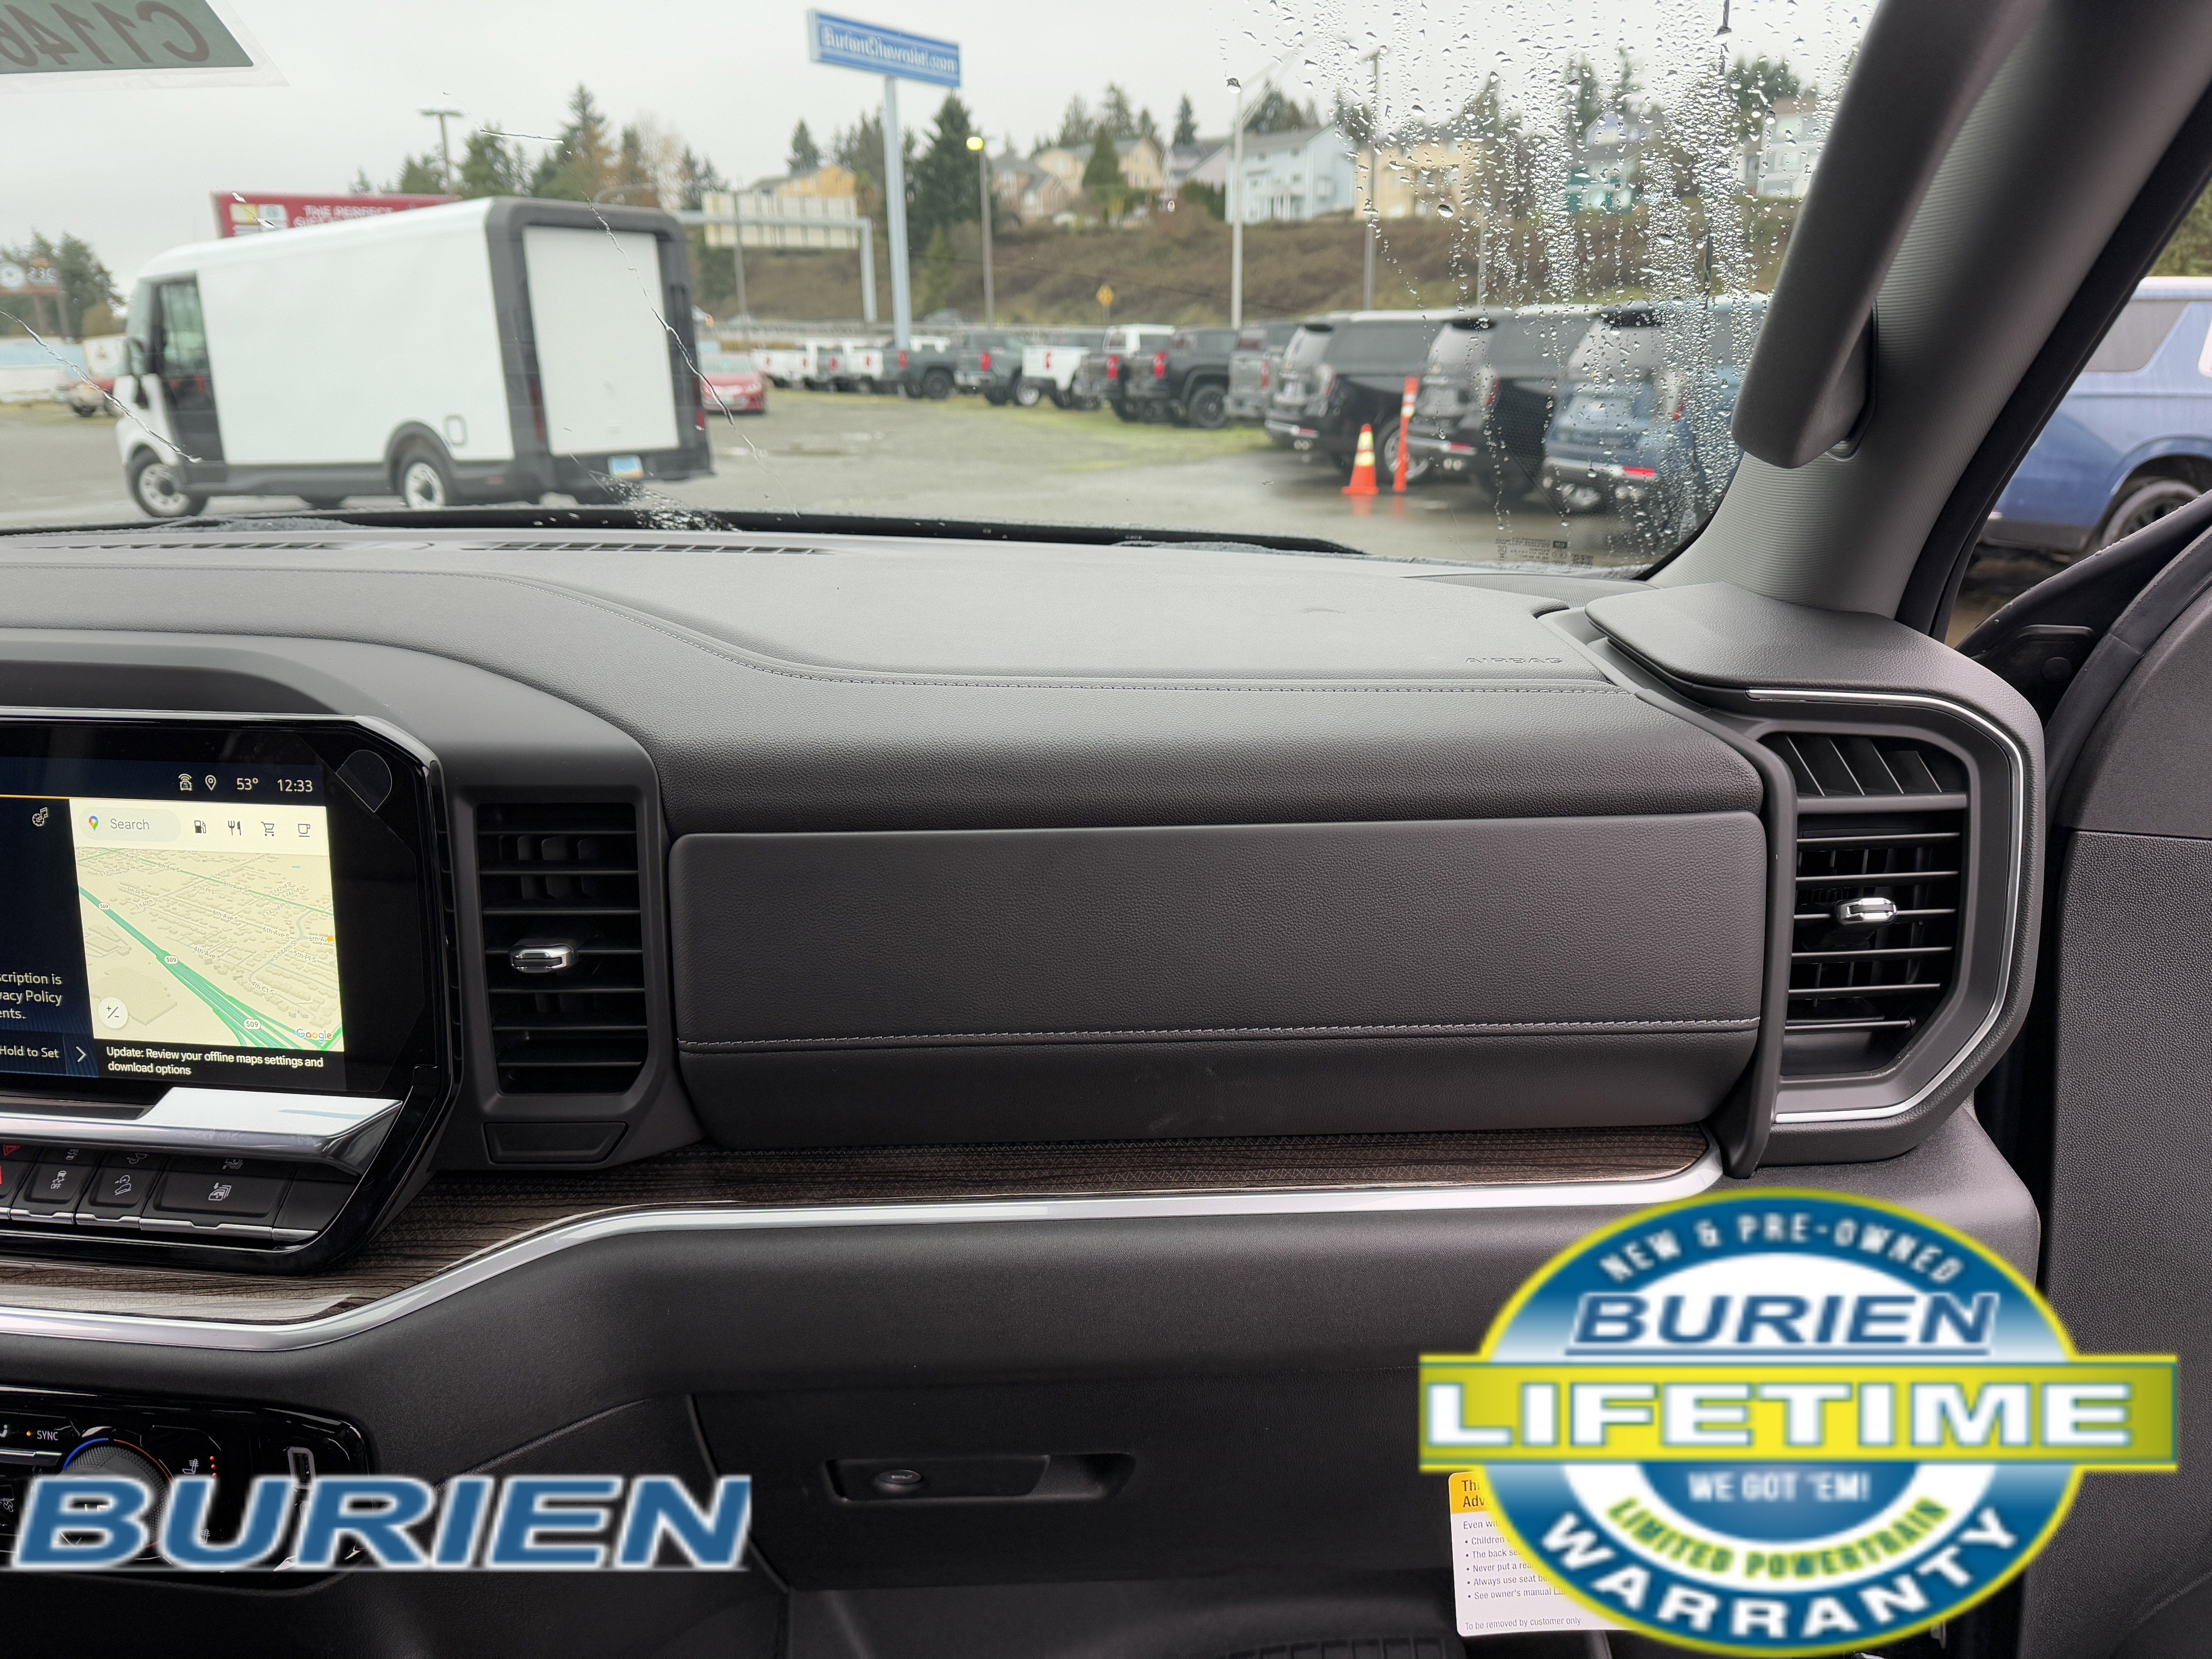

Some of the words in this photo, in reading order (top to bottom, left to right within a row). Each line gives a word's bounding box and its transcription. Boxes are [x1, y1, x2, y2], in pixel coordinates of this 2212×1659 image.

[277, 779, 313, 793] 12:33
[110, 818, 150, 830] Search
[277, 945, 292, 957] 144th
[52, 973, 62, 985] is
[26, 990, 62, 1007] Policy
[296, 1028, 332, 1041] Google
[27, 1048, 38, 1057] to
[41, 1047, 60, 1058] Set
[106, 1046, 144, 1058] Update:
[146, 1048, 179, 1060] Review
[180, 1053, 202, 1062] your
[204, 1051, 234, 1062] offline
[235, 1055, 263, 1065] maps
[264, 1056, 303, 1068] settings
[304, 1057, 324, 1068] and
[108, 1061, 153, 1073] download
[155, 1064, 192, 1076] options
[37, 1430, 59, 1441] SYNC
[1462, 1479, 1483, 1492] Thi
[1463, 1521, 1483, 1529] Even
[1472, 1536, 1504, 1545] Children
[1488, 1549, 1507, 1558] back
[1473, 1564, 1495, 1572] Never
[1498, 1563, 1510, 1571] put
[1474, 1578, 1501, 1586] Always
[1519, 1575, 1536, 1583] seat
[1491, 1589, 1521, 1598] owner's
[1523, 1588, 1551, 1597] manual
[1465, 1622, 1473, 1630] To
[1486, 1619, 1517, 1628] removed
[1519, 1618, 1528, 1627] by
[1530, 1618, 1564, 1626] customer
